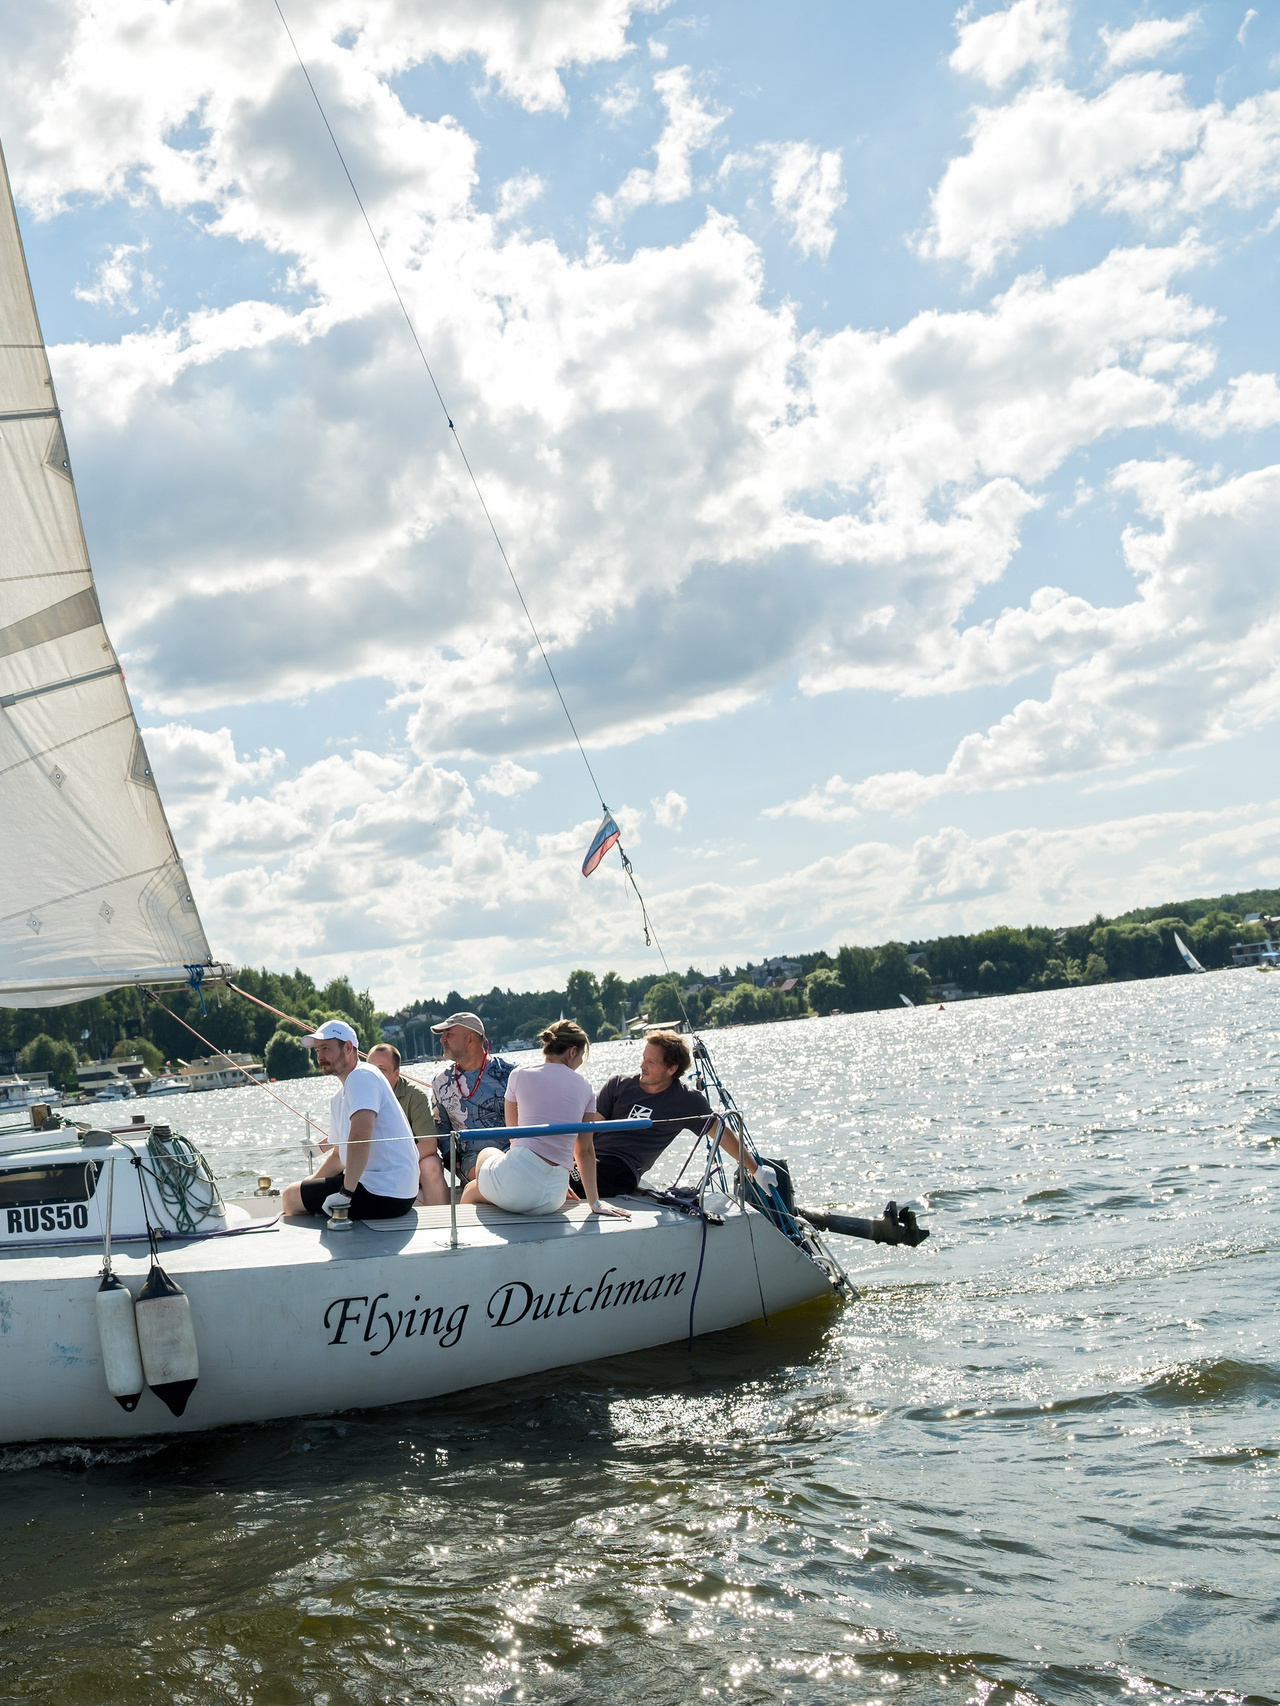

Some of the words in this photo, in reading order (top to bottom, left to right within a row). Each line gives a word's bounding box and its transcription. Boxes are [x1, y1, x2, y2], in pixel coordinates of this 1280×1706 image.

[7, 1204, 89, 1234] RUS50
[323, 1292, 471, 1357] Flying
[486, 1267, 687, 1328] Dutchman
